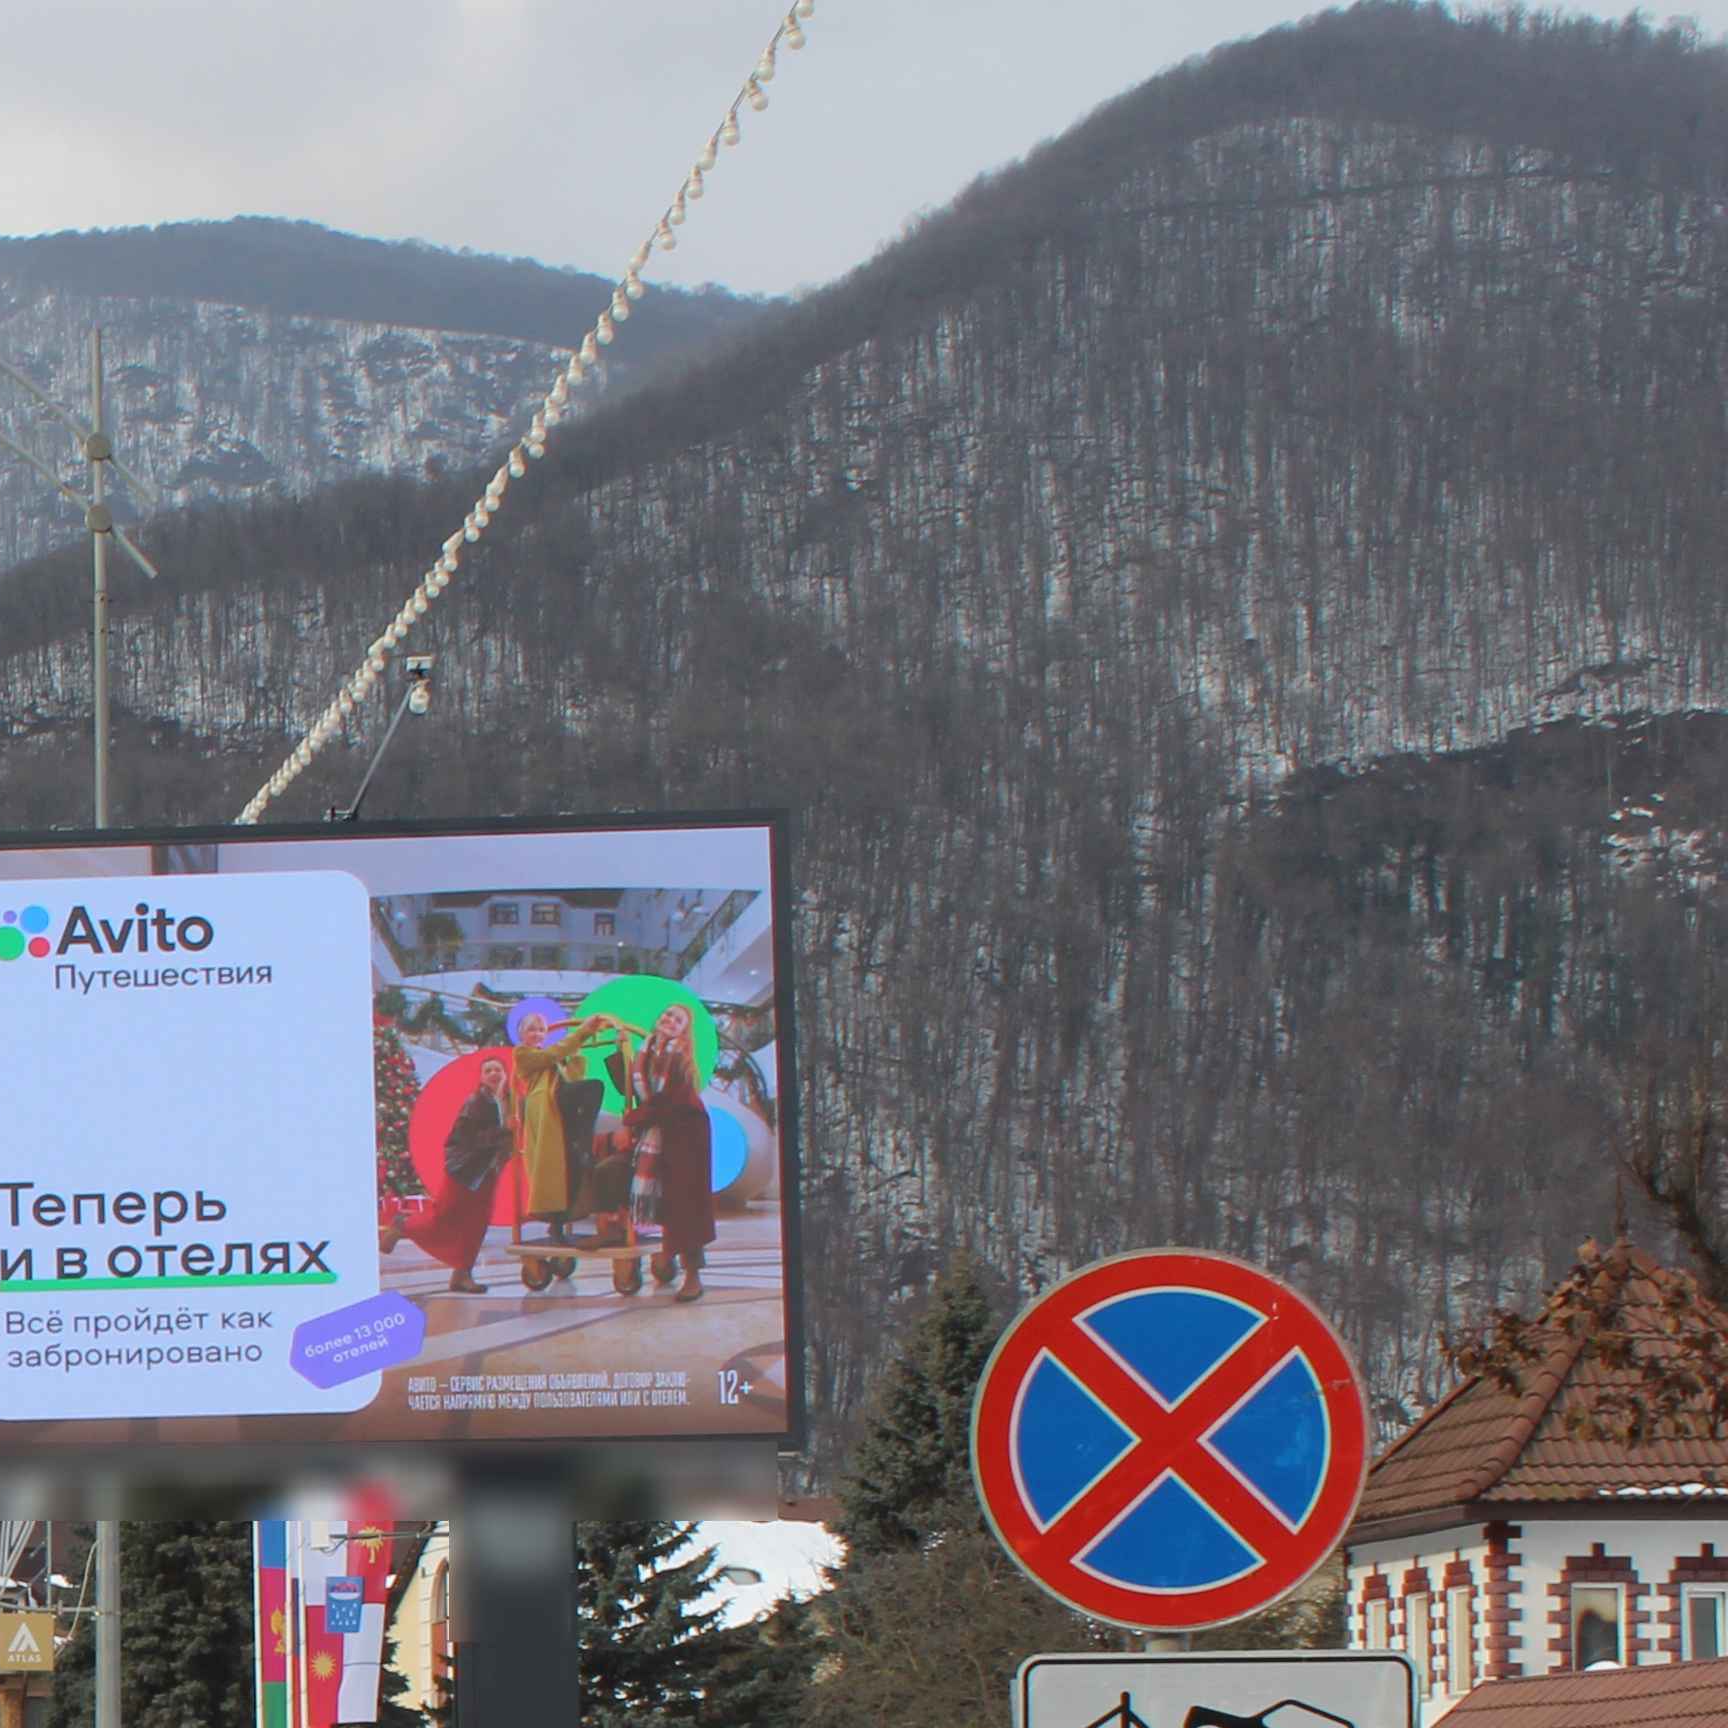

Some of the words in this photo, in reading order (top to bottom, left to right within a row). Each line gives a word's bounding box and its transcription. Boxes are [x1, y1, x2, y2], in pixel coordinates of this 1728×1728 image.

[55, 902, 214, 956] Avito
[54, 963, 272, 995] Путешествия
[0, 1248, 33, 1281] и
[56, 1247, 89, 1280] в
[107, 1240, 332, 1278] отелях
[5, 1309, 63, 1335] Всё
[73, 1306, 209, 1339] пройдёт
[221, 1310, 273, 1330] как
[304, 1333, 353, 1358] более
[353, 1325, 372, 1340] 13
[373, 1312, 406, 1333] 000
[7, 1341, 263, 1373] забронировано
[332, 1333, 389, 1363] отелей
[717, 1369, 754, 1405] 12+
[6, 1653, 42, 1663] ATLAS
